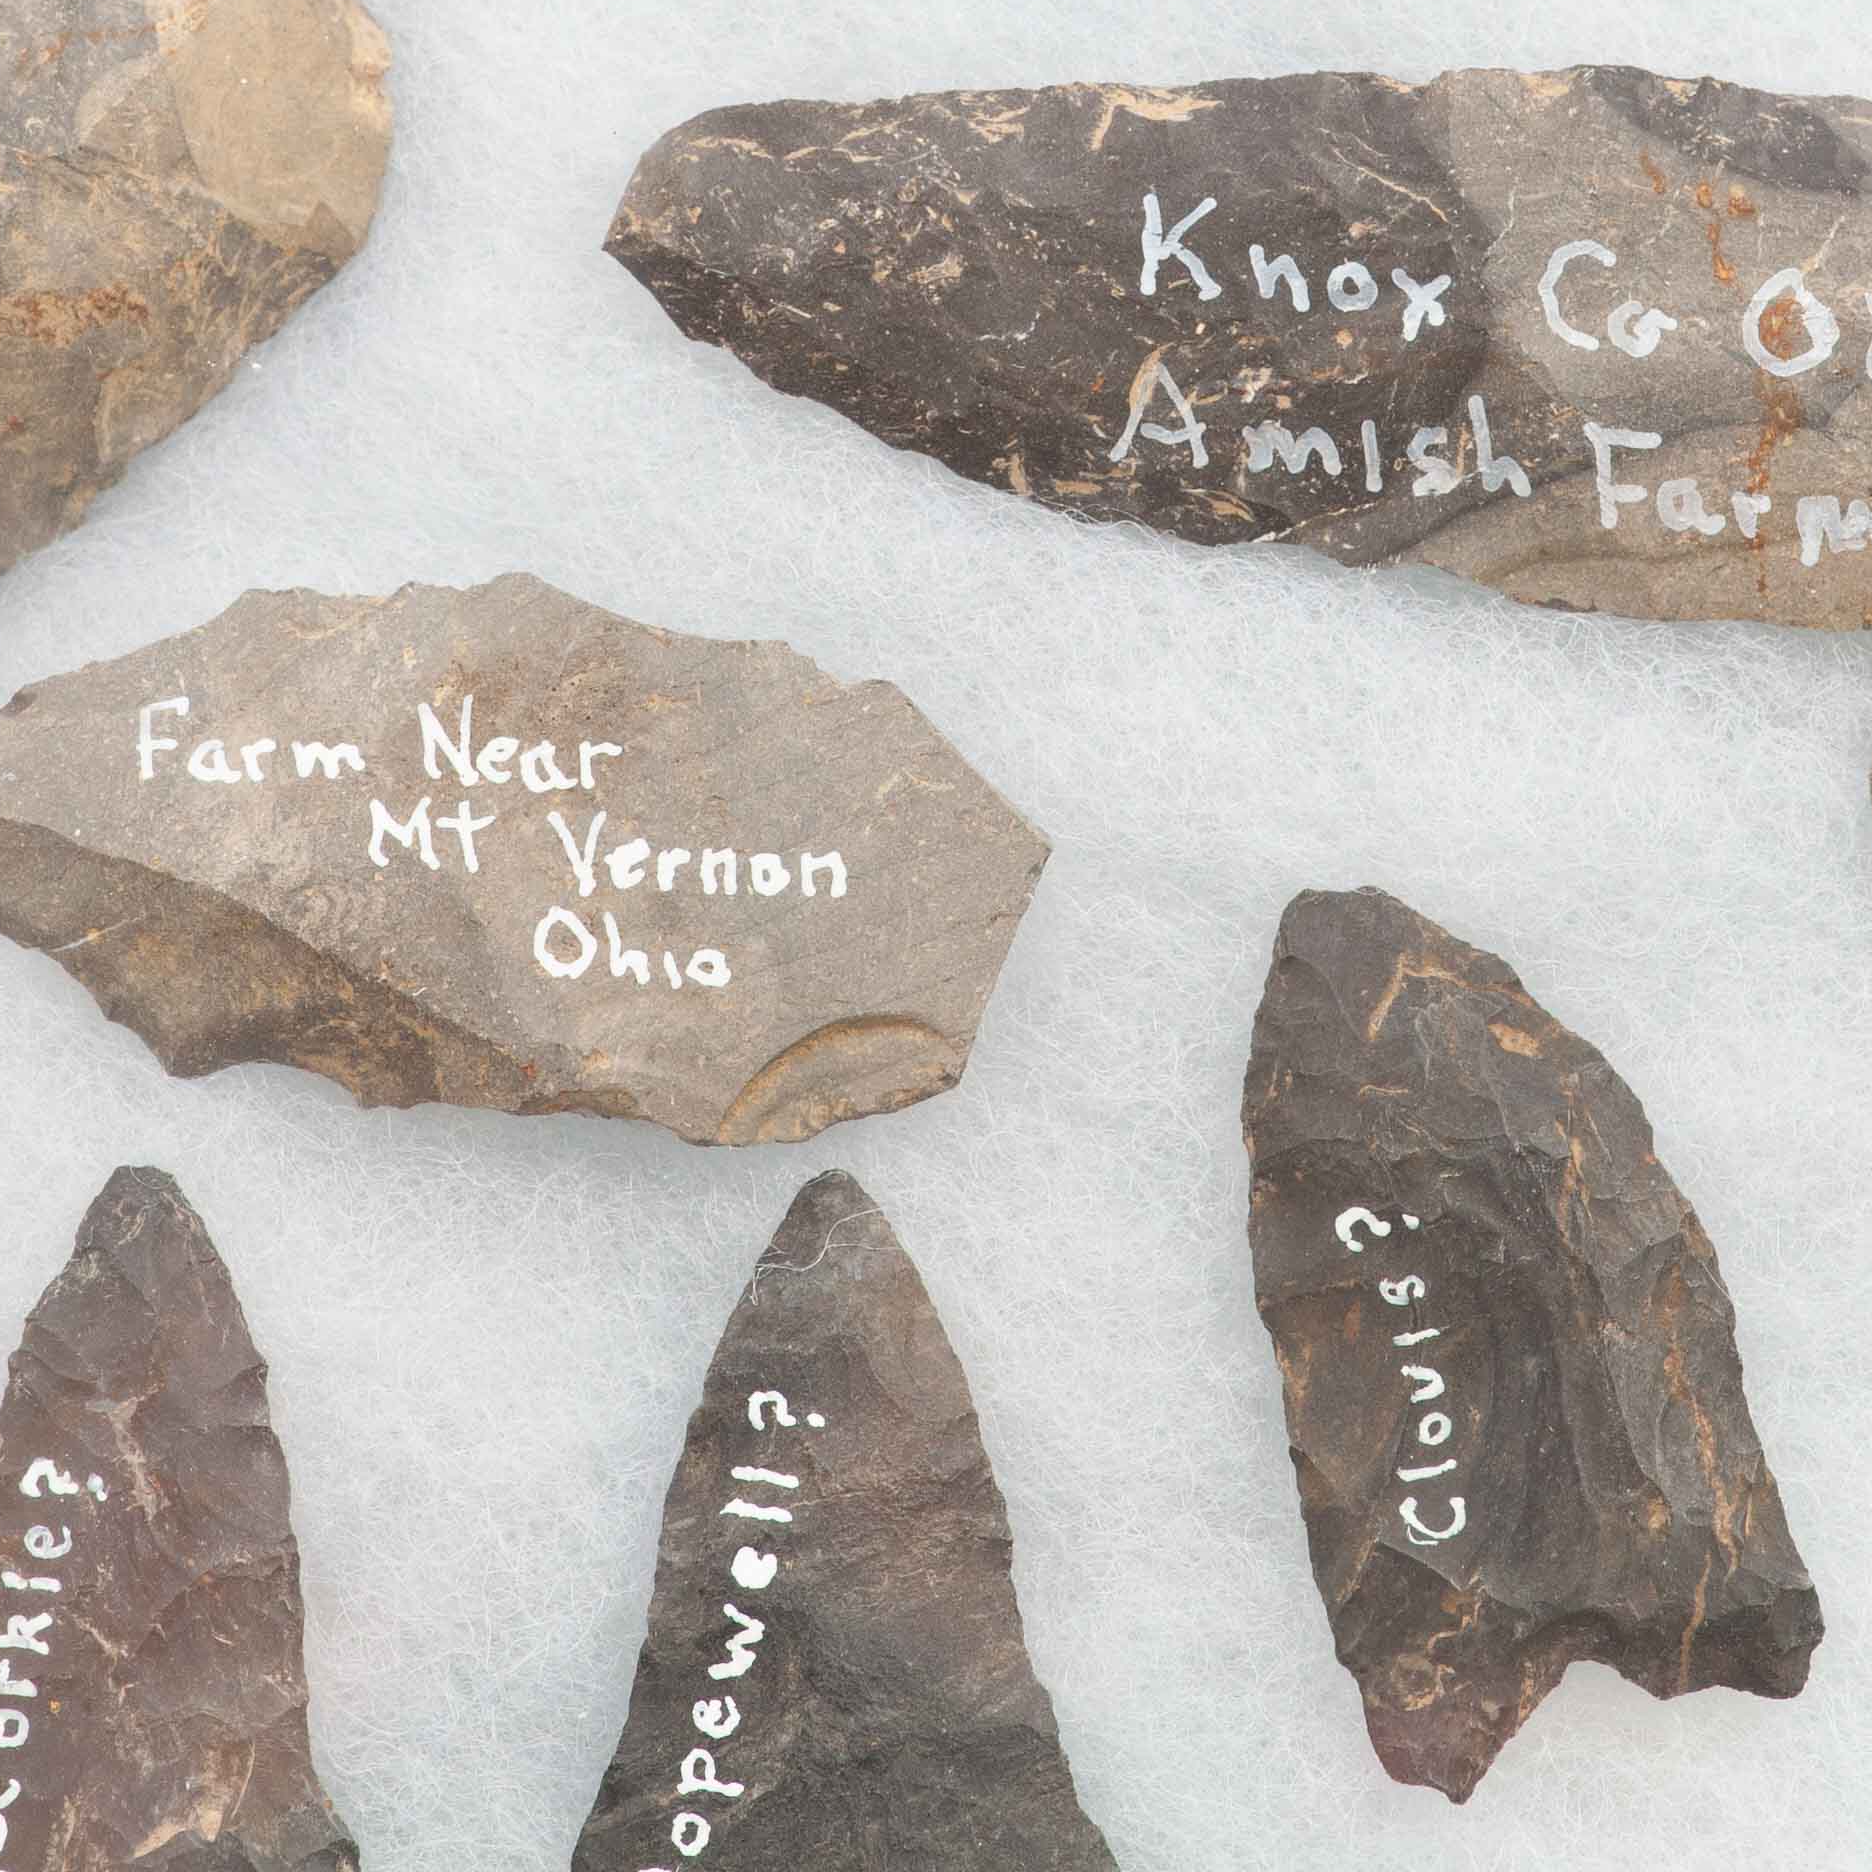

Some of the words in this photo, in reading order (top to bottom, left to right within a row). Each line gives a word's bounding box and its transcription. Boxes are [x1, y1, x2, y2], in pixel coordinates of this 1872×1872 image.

[1139, 193, 1452, 342] Knox
[1539, 238, 1678, 360] Co
[1110, 338, 1532, 497] Amish
[135, 696, 366, 784] Farm
[418, 694, 623, 793] Near
[368, 796, 496, 874] Mt
[547, 810, 850, 898] Vernon
[533, 905, 732, 990] Ohio
[1335, 1206, 1467, 1546] Clovis?
[634, 1390, 826, 1872] opewell?
